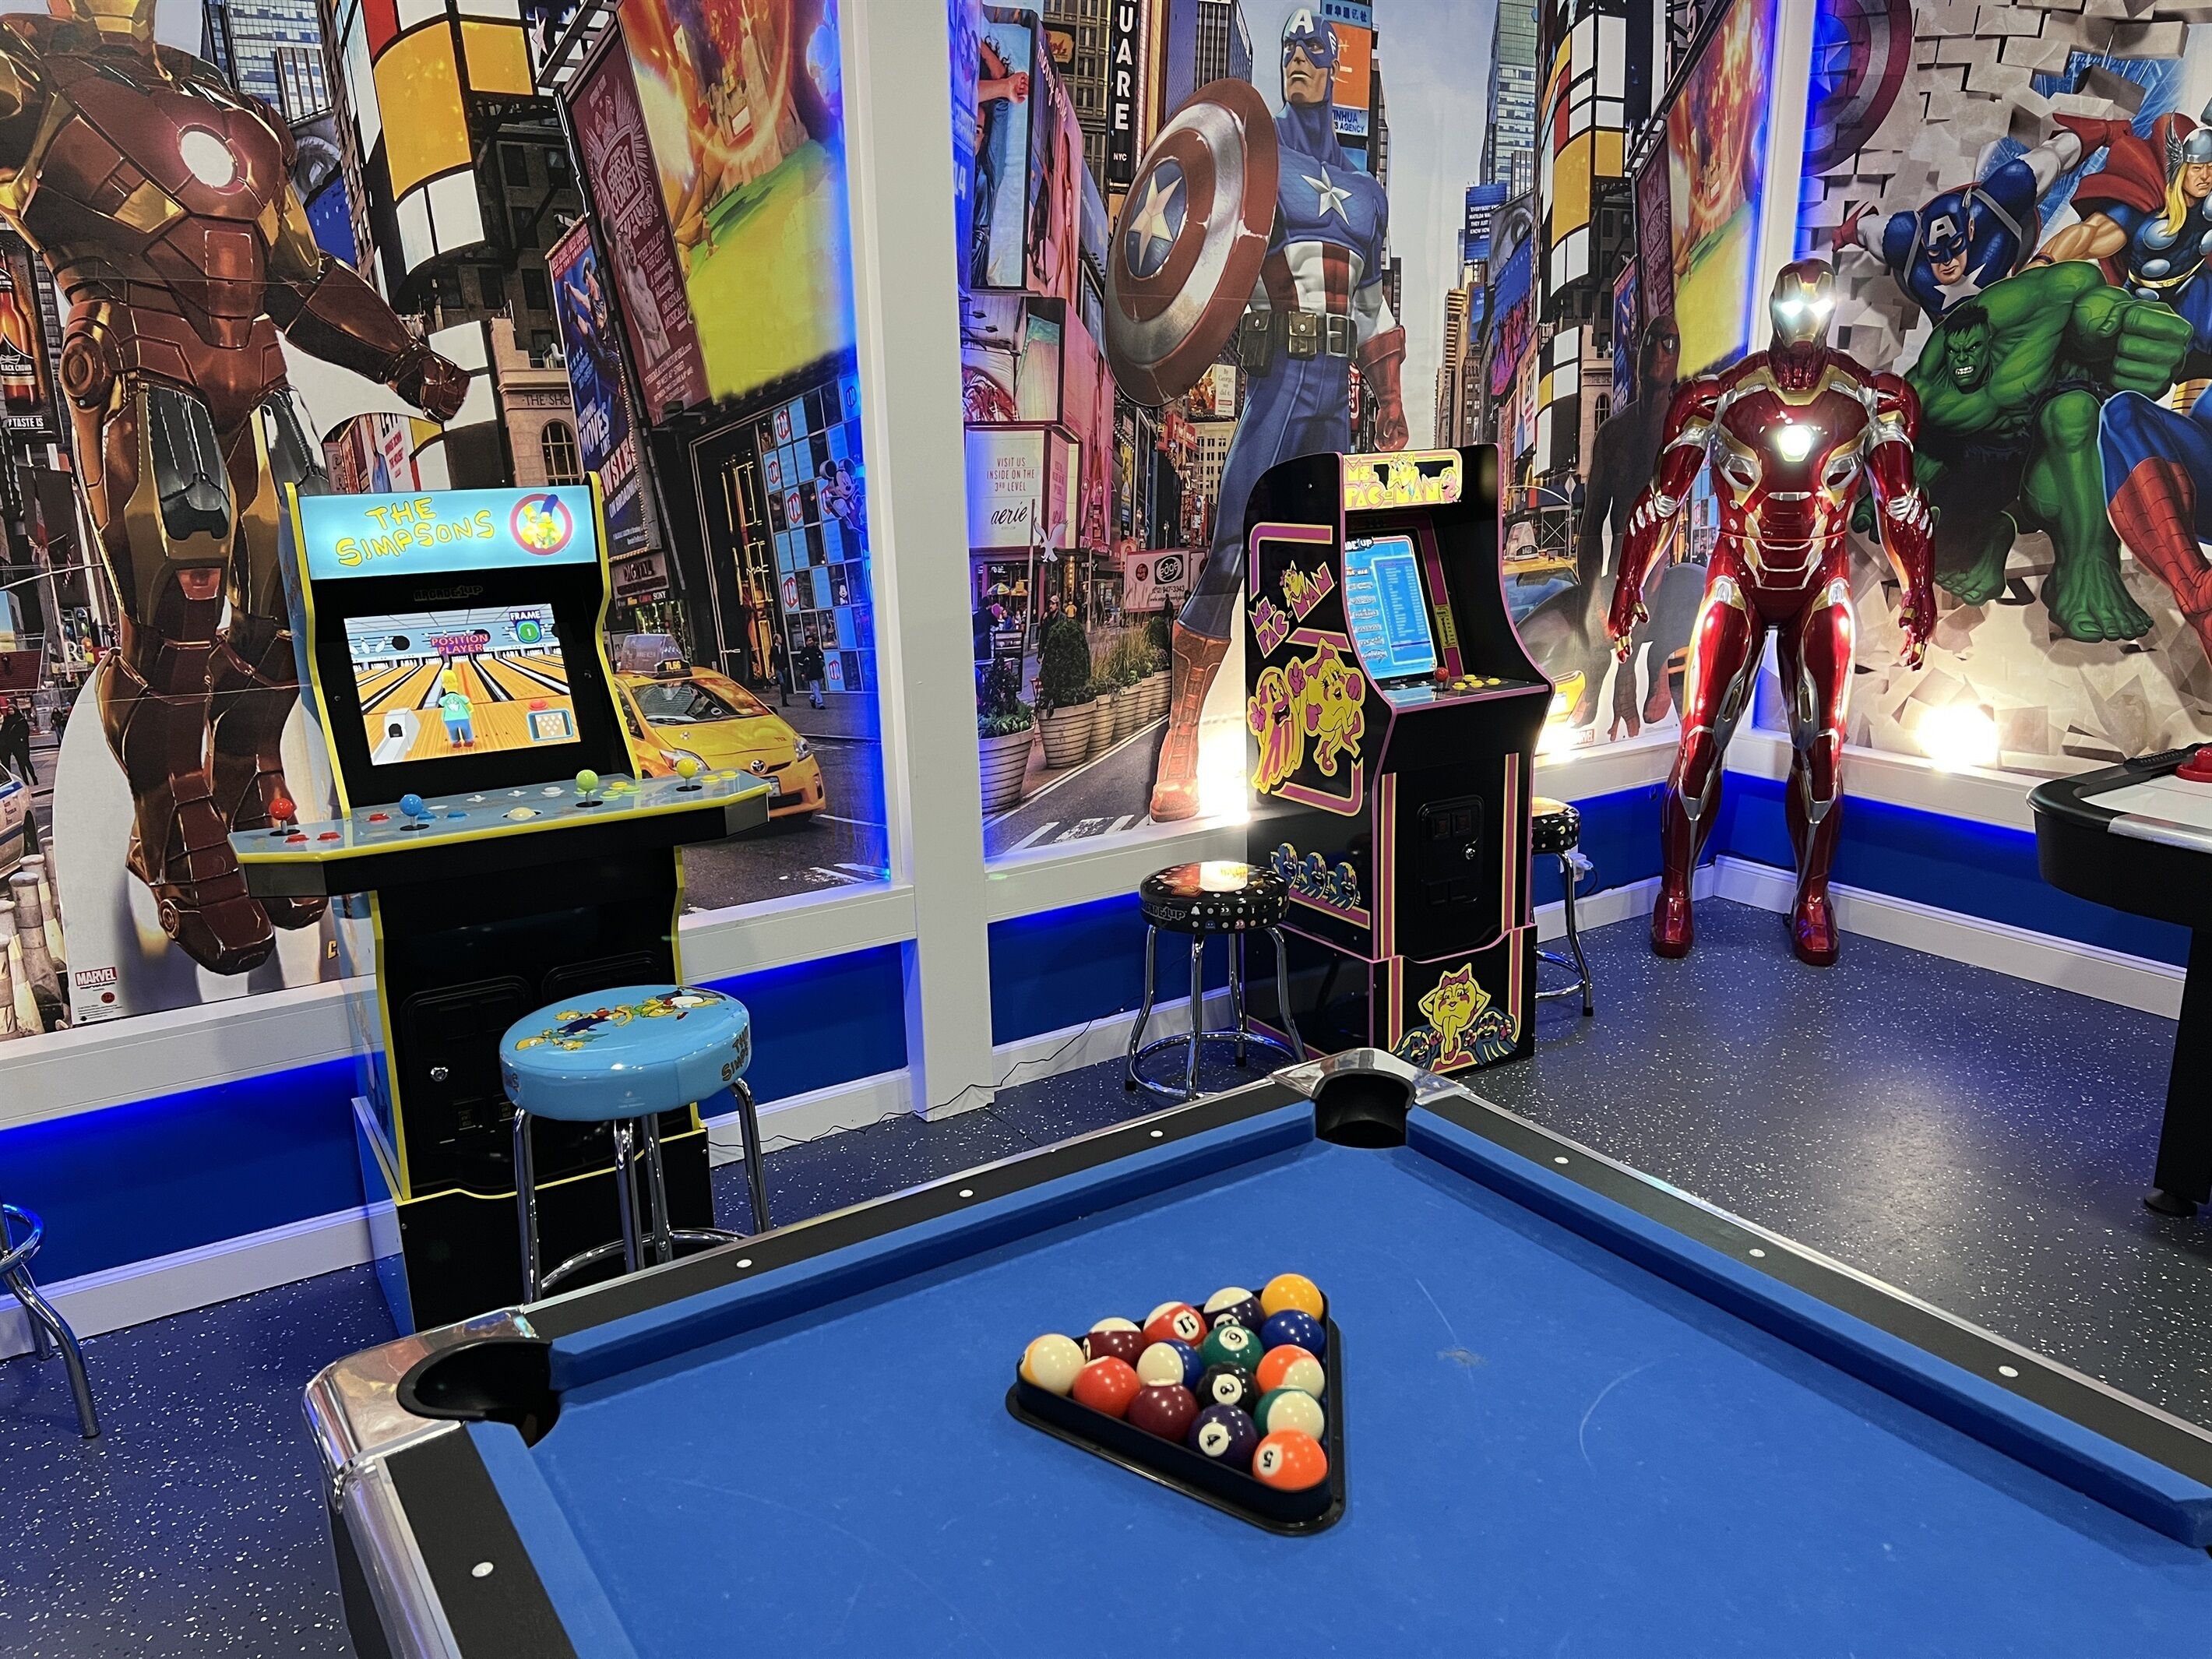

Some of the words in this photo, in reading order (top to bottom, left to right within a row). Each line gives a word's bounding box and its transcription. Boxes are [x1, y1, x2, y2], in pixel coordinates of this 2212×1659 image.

[1115, 0, 1136, 130] UARE
[1340, 123, 1365, 134] AGENCY
[1113, 152, 1127, 161] NYC
[607, 145, 634, 190] GREAT
[611, 165, 638, 214] COMET
[523, 393, 545, 407] THE
[548, 393, 571, 406] SHO
[579, 405, 610, 456] MOVES
[600, 433, 611, 458] LIKE
[997, 457, 1014, 467] VISIT
[1016, 457, 1026, 467] US
[987, 470, 1009, 480] INSIDE
[1012, 470, 1021, 479] ON
[1023, 469, 1035, 479] THE
[995, 482, 1006, 491] 3RD
[1007, 481, 1027, 491] LEVEL
[1345, 474, 1441, 509] PAC-MAN
[365, 496, 437, 530] THE
[991, 502, 1027, 525] aerie
[335, 509, 495, 567] SIMPSONS
[1160, 560, 1178, 577] edge
[509, 610, 541, 621] FRAME
[431, 633, 488, 646] POSITION
[527, 628, 532, 637] 1
[438, 643, 483, 655] PLAYER
[76, 968, 117, 986] MARVEL
[1220, 1382, 1235, 1395] 8
[1206, 1434, 1221, 1447] 4
[1263, 1449, 1273, 1468] 5
